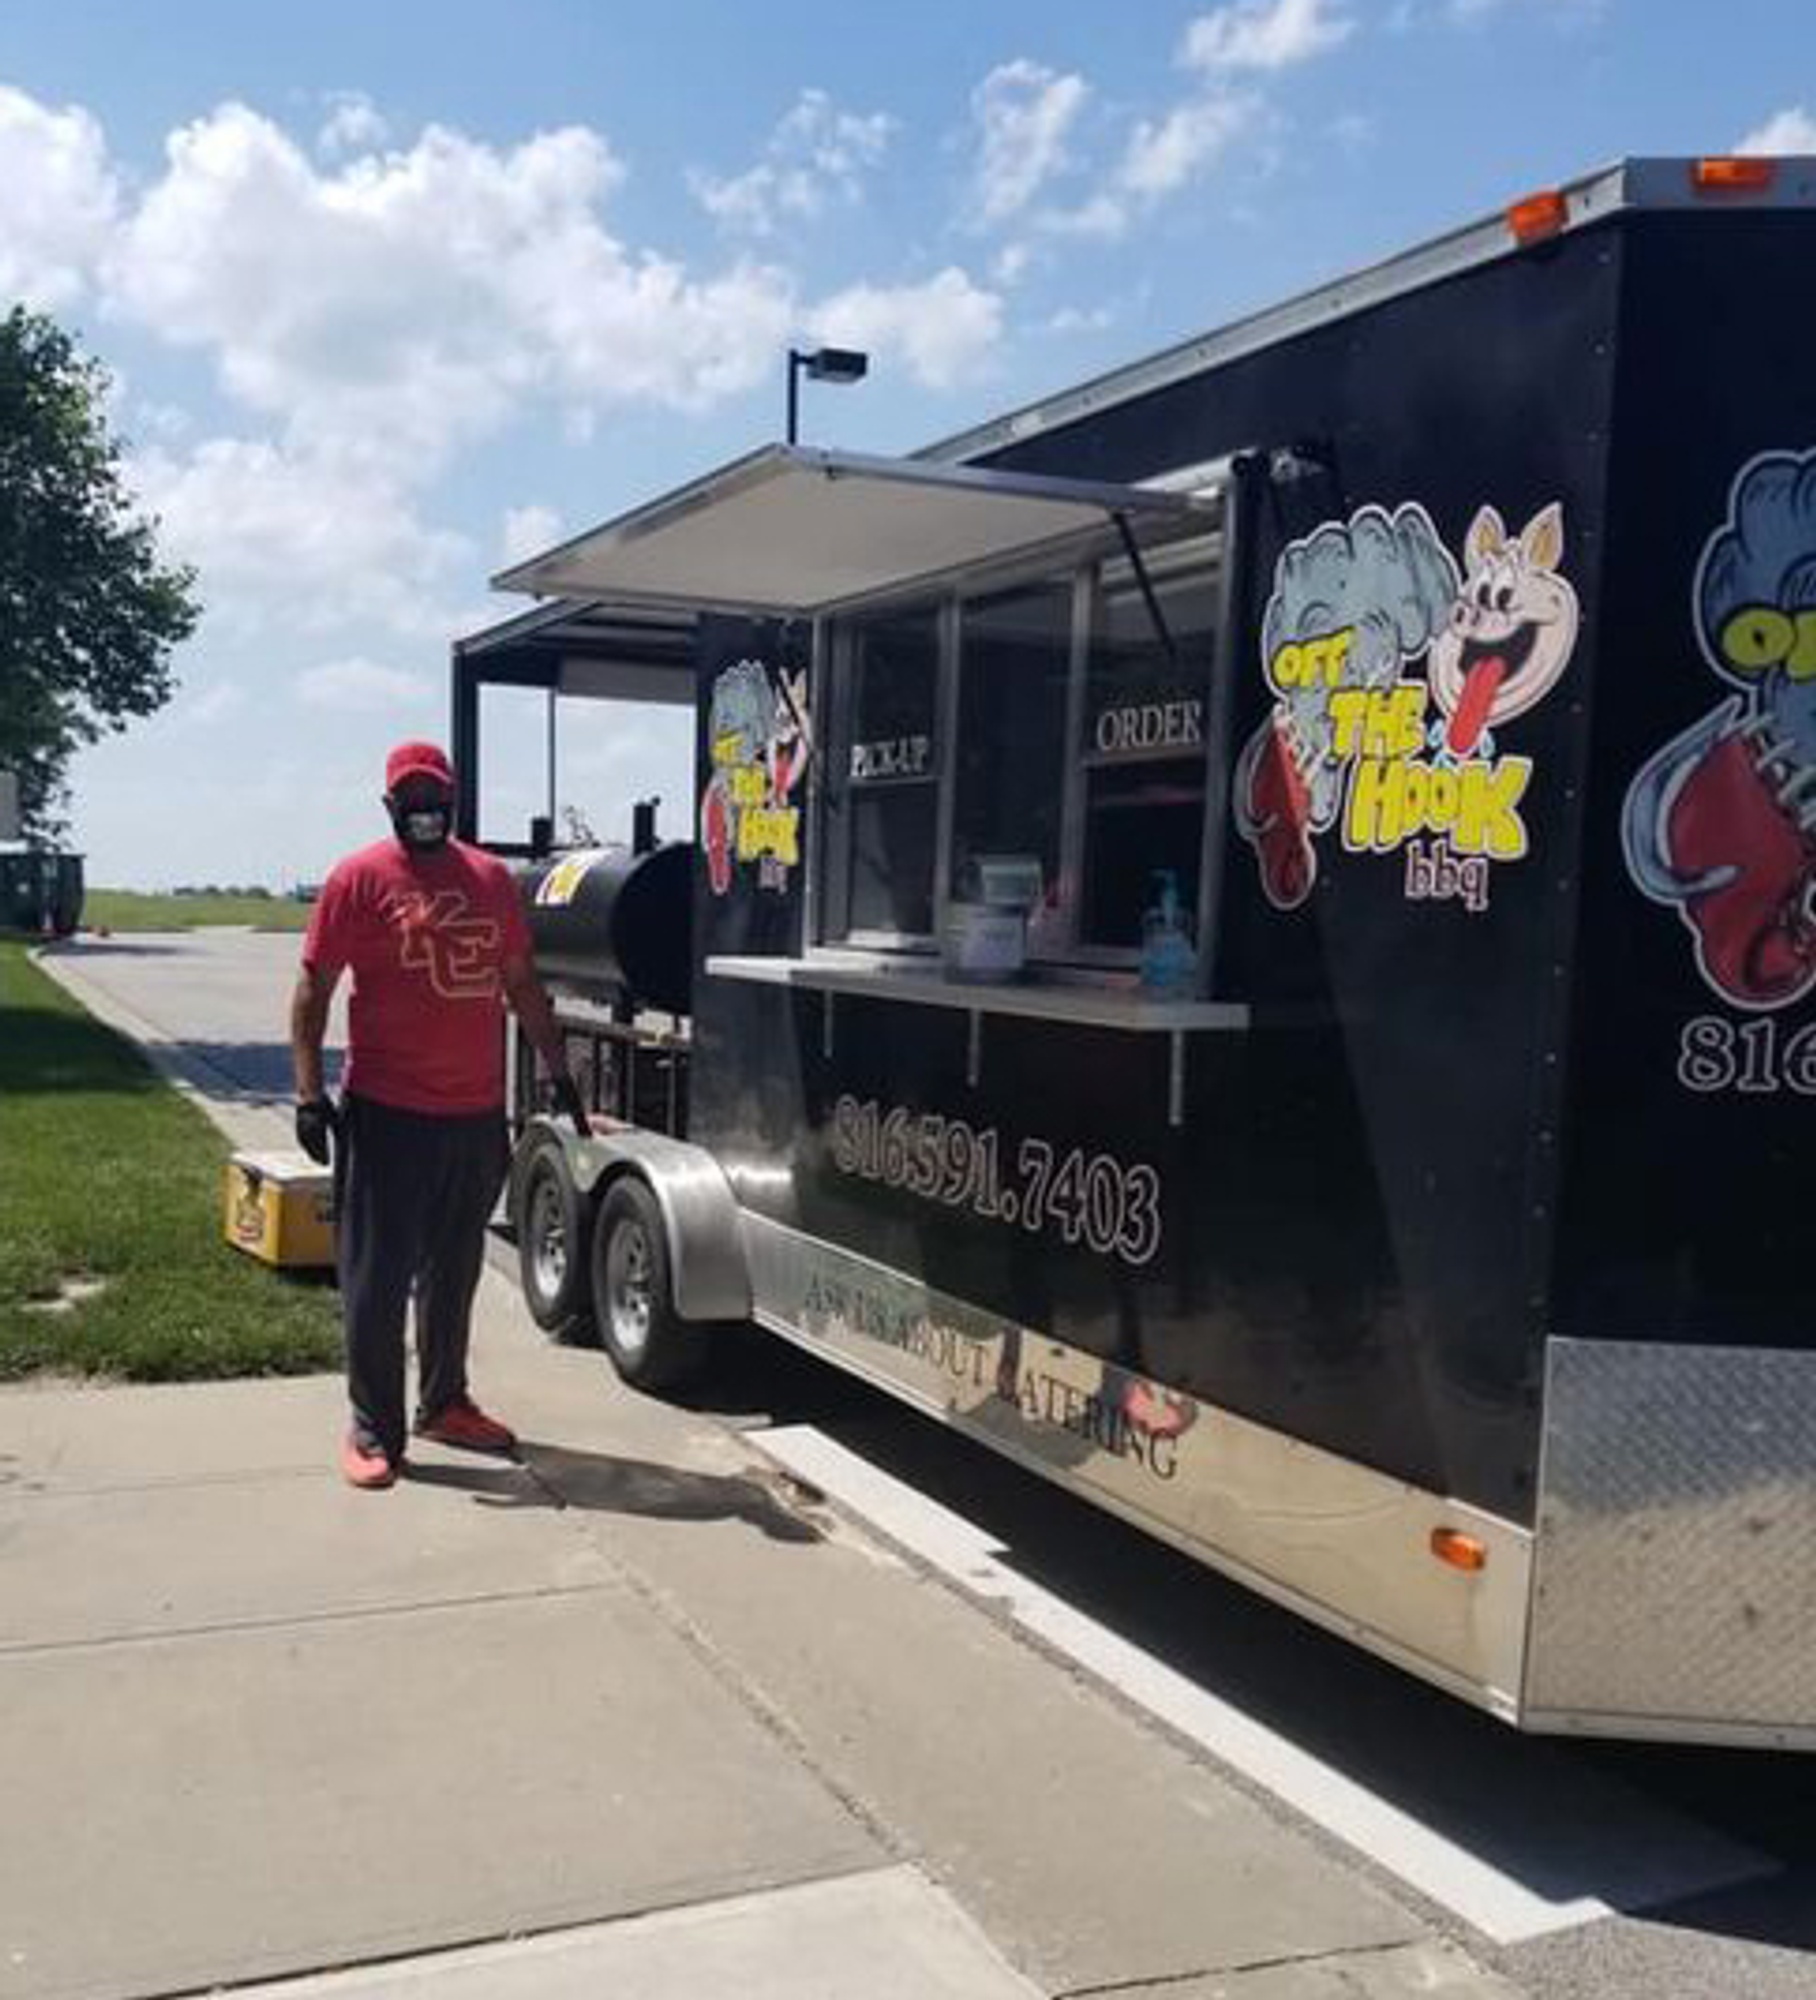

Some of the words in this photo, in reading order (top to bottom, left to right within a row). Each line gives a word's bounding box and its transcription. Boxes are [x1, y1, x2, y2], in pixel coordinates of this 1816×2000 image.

[1272, 625, 1357, 689] OFF
[1097, 700, 1201, 750] ORDER
[1327, 680, 1428, 760] THE
[737, 803, 800, 867] HOOK
[1346, 755, 1532, 858] HOOK
[1405, 841, 1489, 912] bbq
